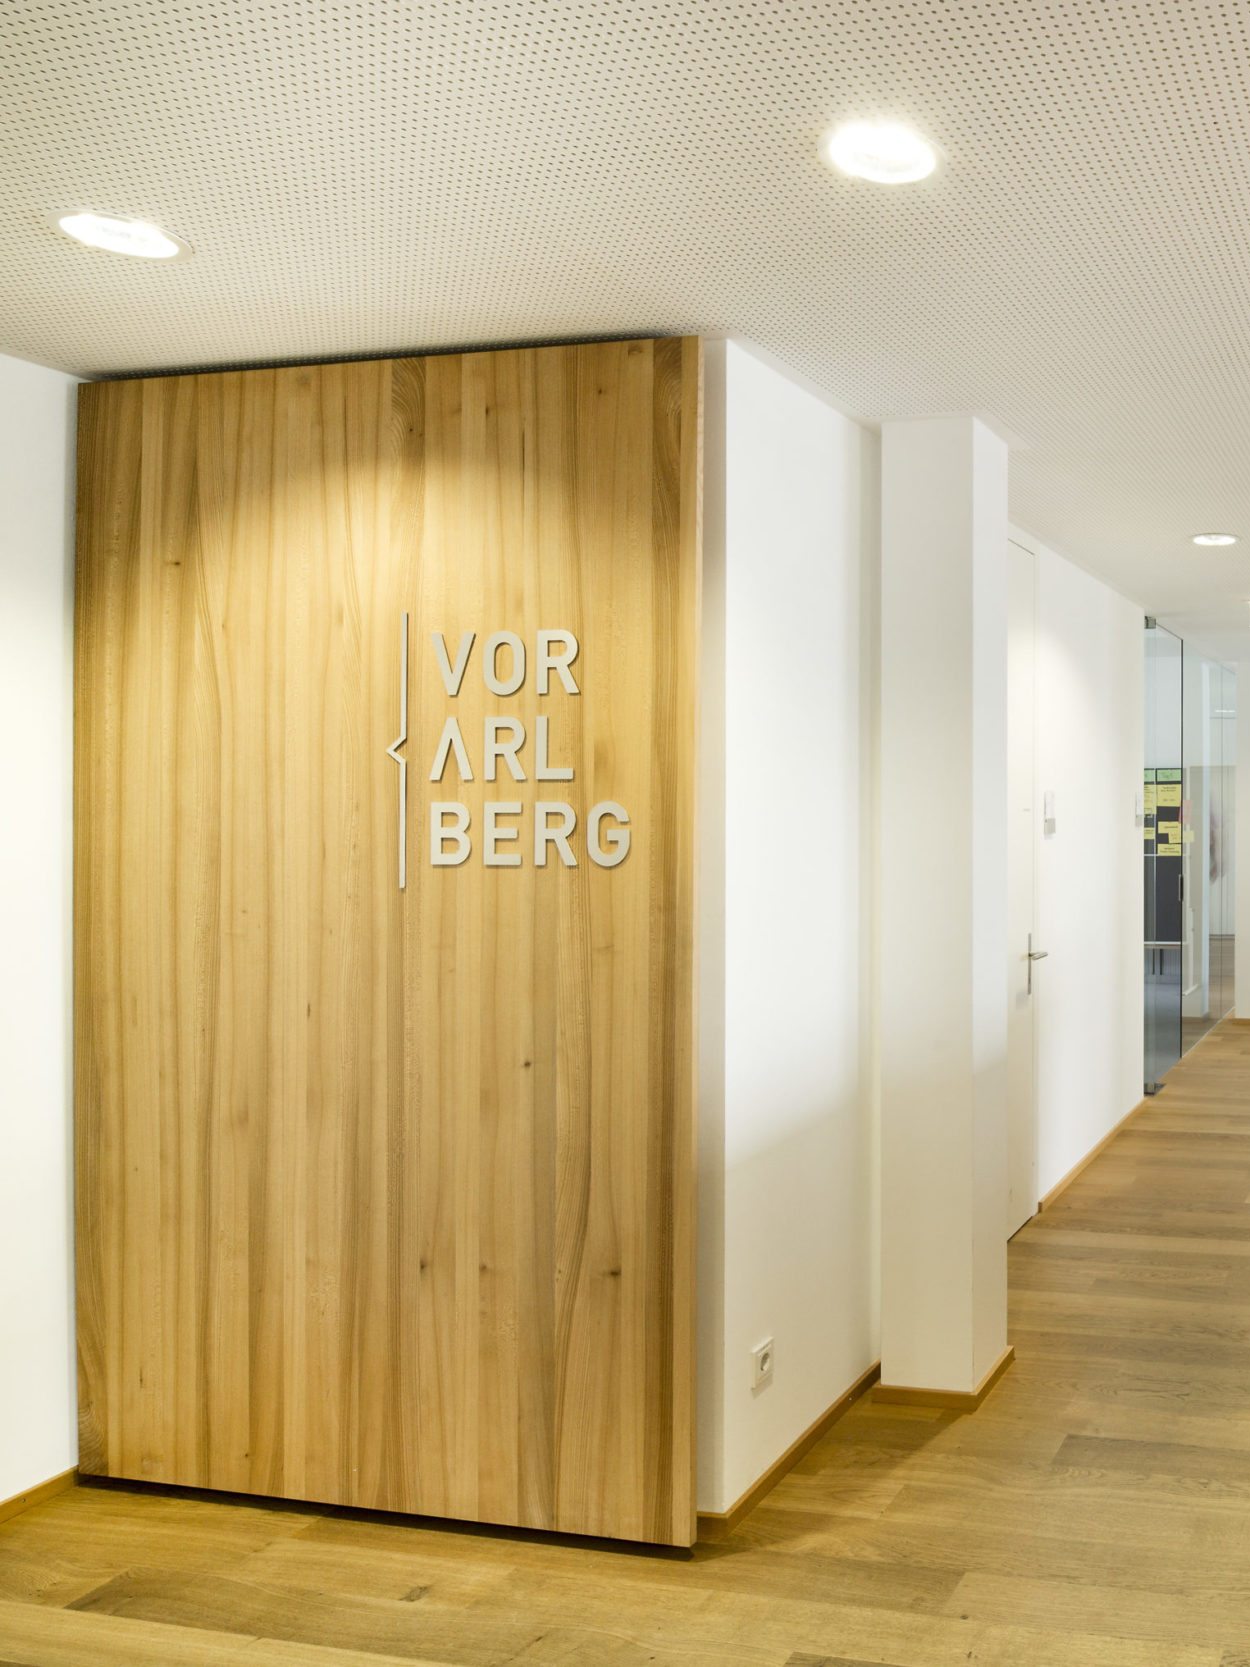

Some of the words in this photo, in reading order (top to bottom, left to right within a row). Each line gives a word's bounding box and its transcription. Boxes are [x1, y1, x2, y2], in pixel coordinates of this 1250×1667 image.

[431, 629, 579, 695] VOR
[429, 715, 574, 781] ARL
[430, 801, 630, 867] BERG
